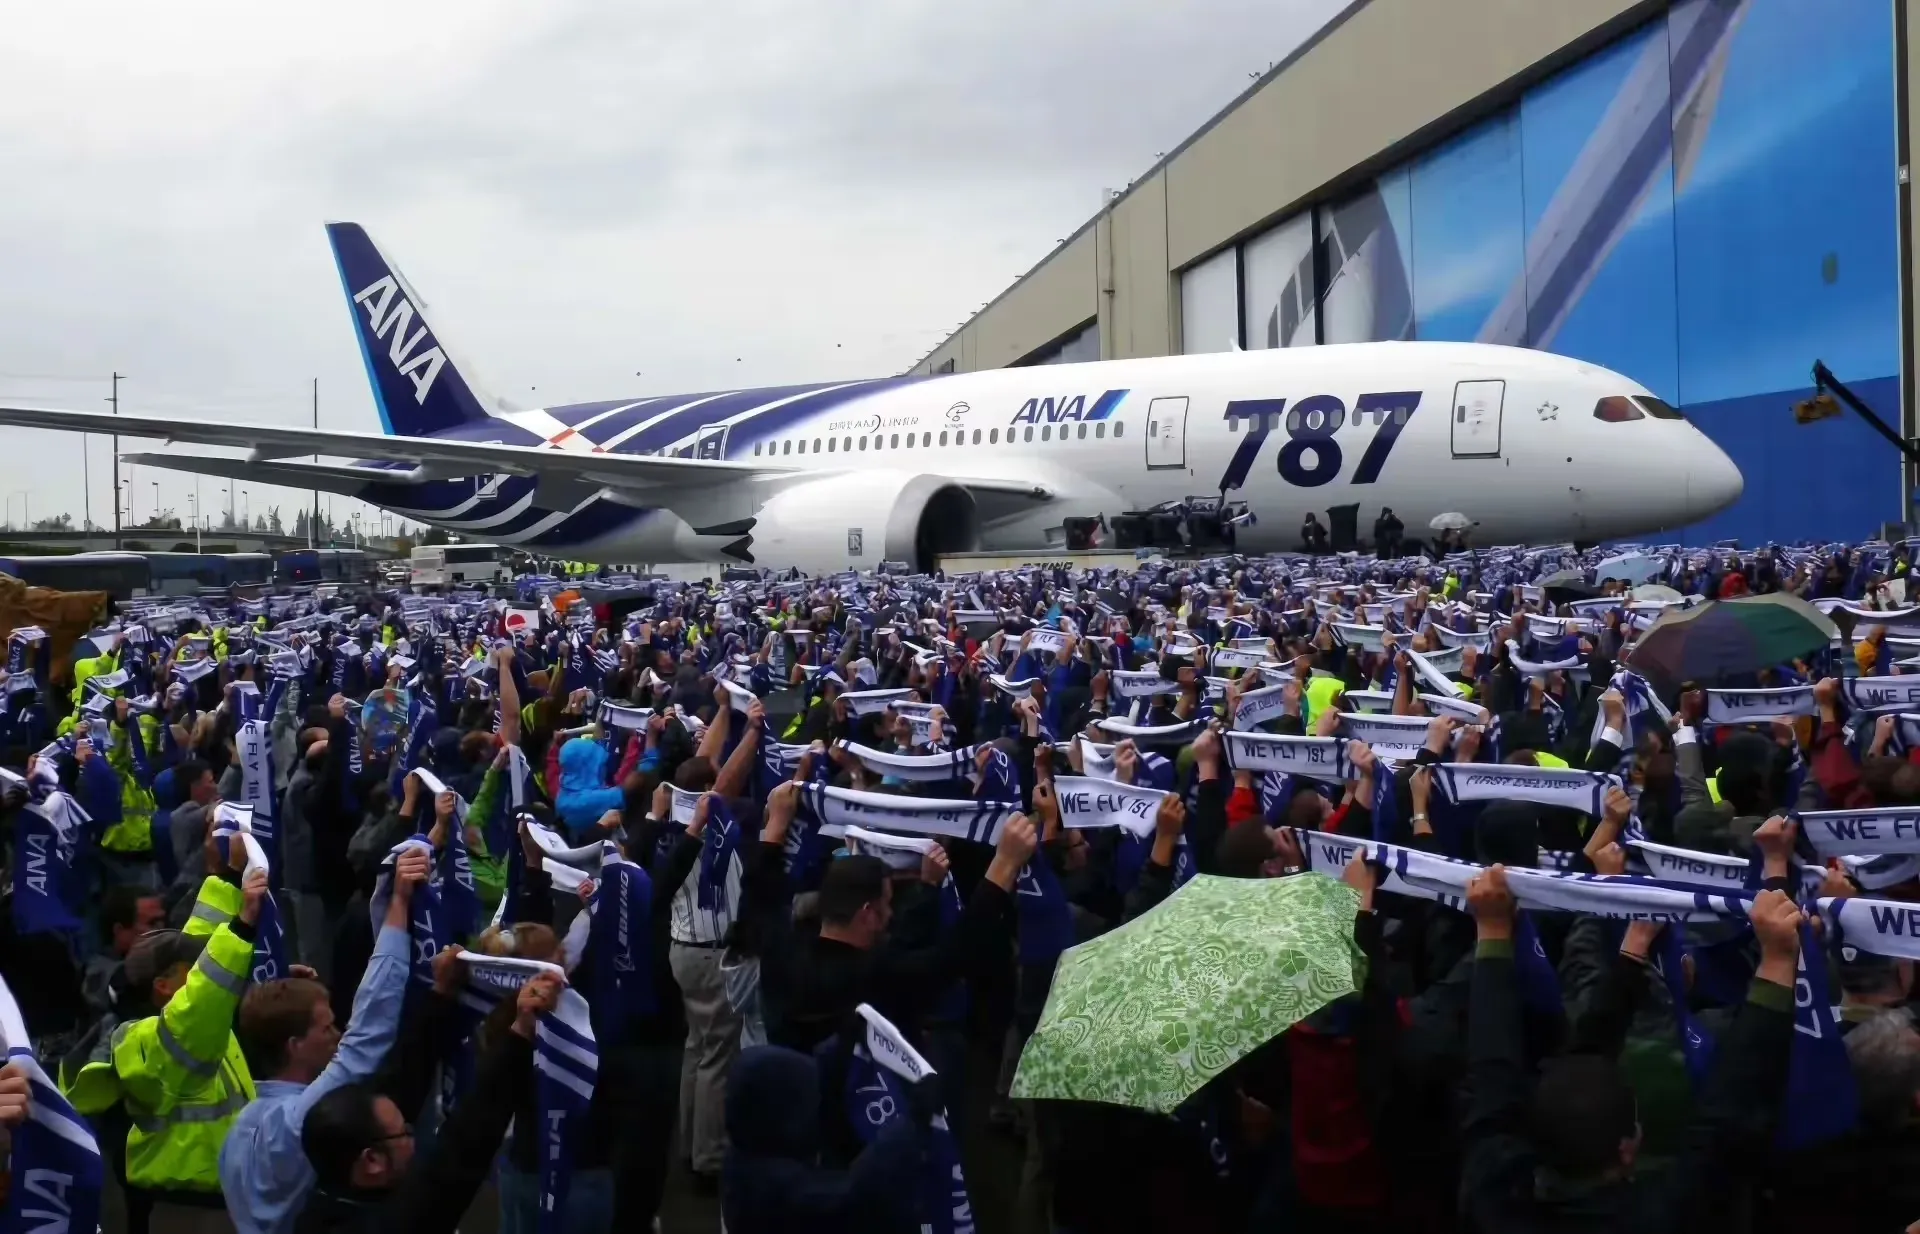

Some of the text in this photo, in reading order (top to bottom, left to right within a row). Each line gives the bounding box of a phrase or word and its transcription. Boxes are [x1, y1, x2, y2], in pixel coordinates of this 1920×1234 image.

[353, 274, 447, 406] ANA
[1010, 395, 1087, 425] ANA
[1219, 391, 1423, 490] 787
[1866, 688, 1897, 702] WE
[993, 747, 1009, 787] 87
[1243, 743, 1326, 764] WE FLY 1st
[1061, 792, 1091, 814] WE
[1824, 817, 1881, 841] WE
[26, 833, 51, 897] ANA
[1660, 856, 1716, 876] FIRST
[254, 936, 278, 985] 78
[855, 1071, 896, 1125] 78
